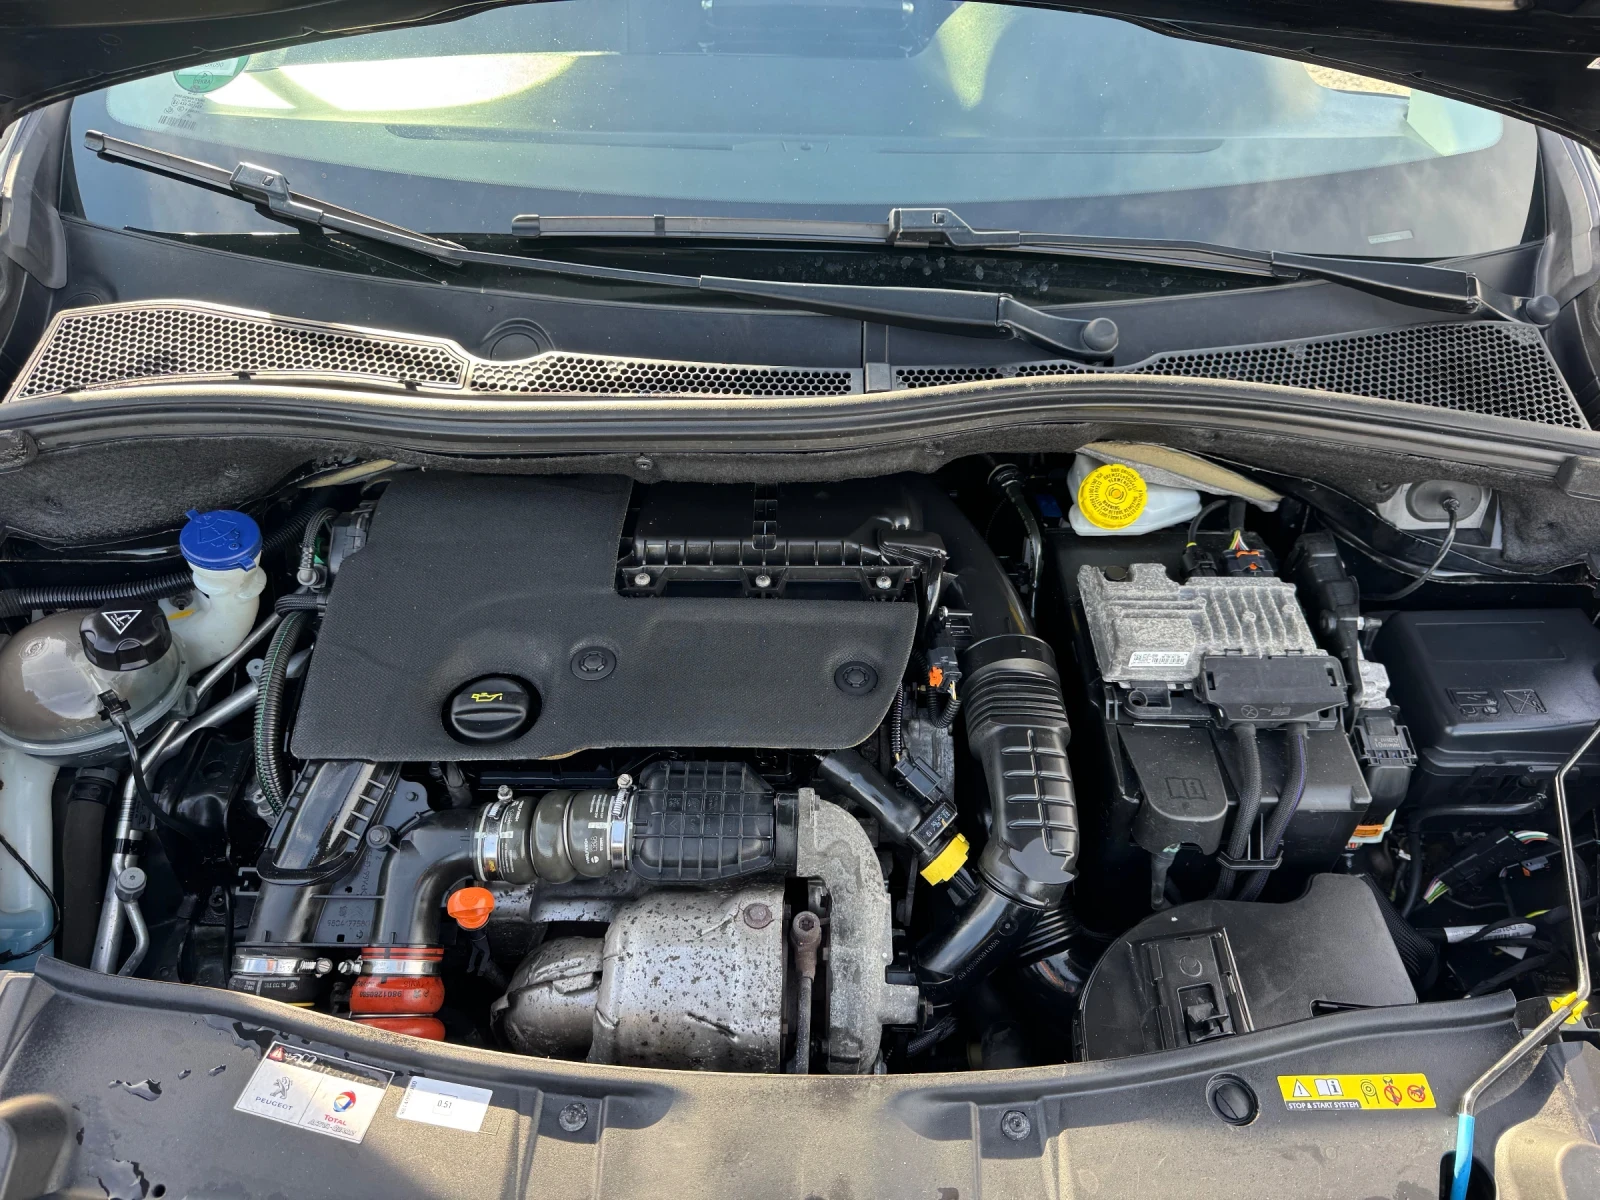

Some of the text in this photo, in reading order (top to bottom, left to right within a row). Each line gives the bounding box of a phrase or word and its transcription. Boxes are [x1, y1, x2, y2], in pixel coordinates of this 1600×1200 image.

[1102, 500, 1120, 510] WARNING
[255, 1096, 293, 1111] PEUGEOT
[324, 1114, 347, 1126] TOTAL
